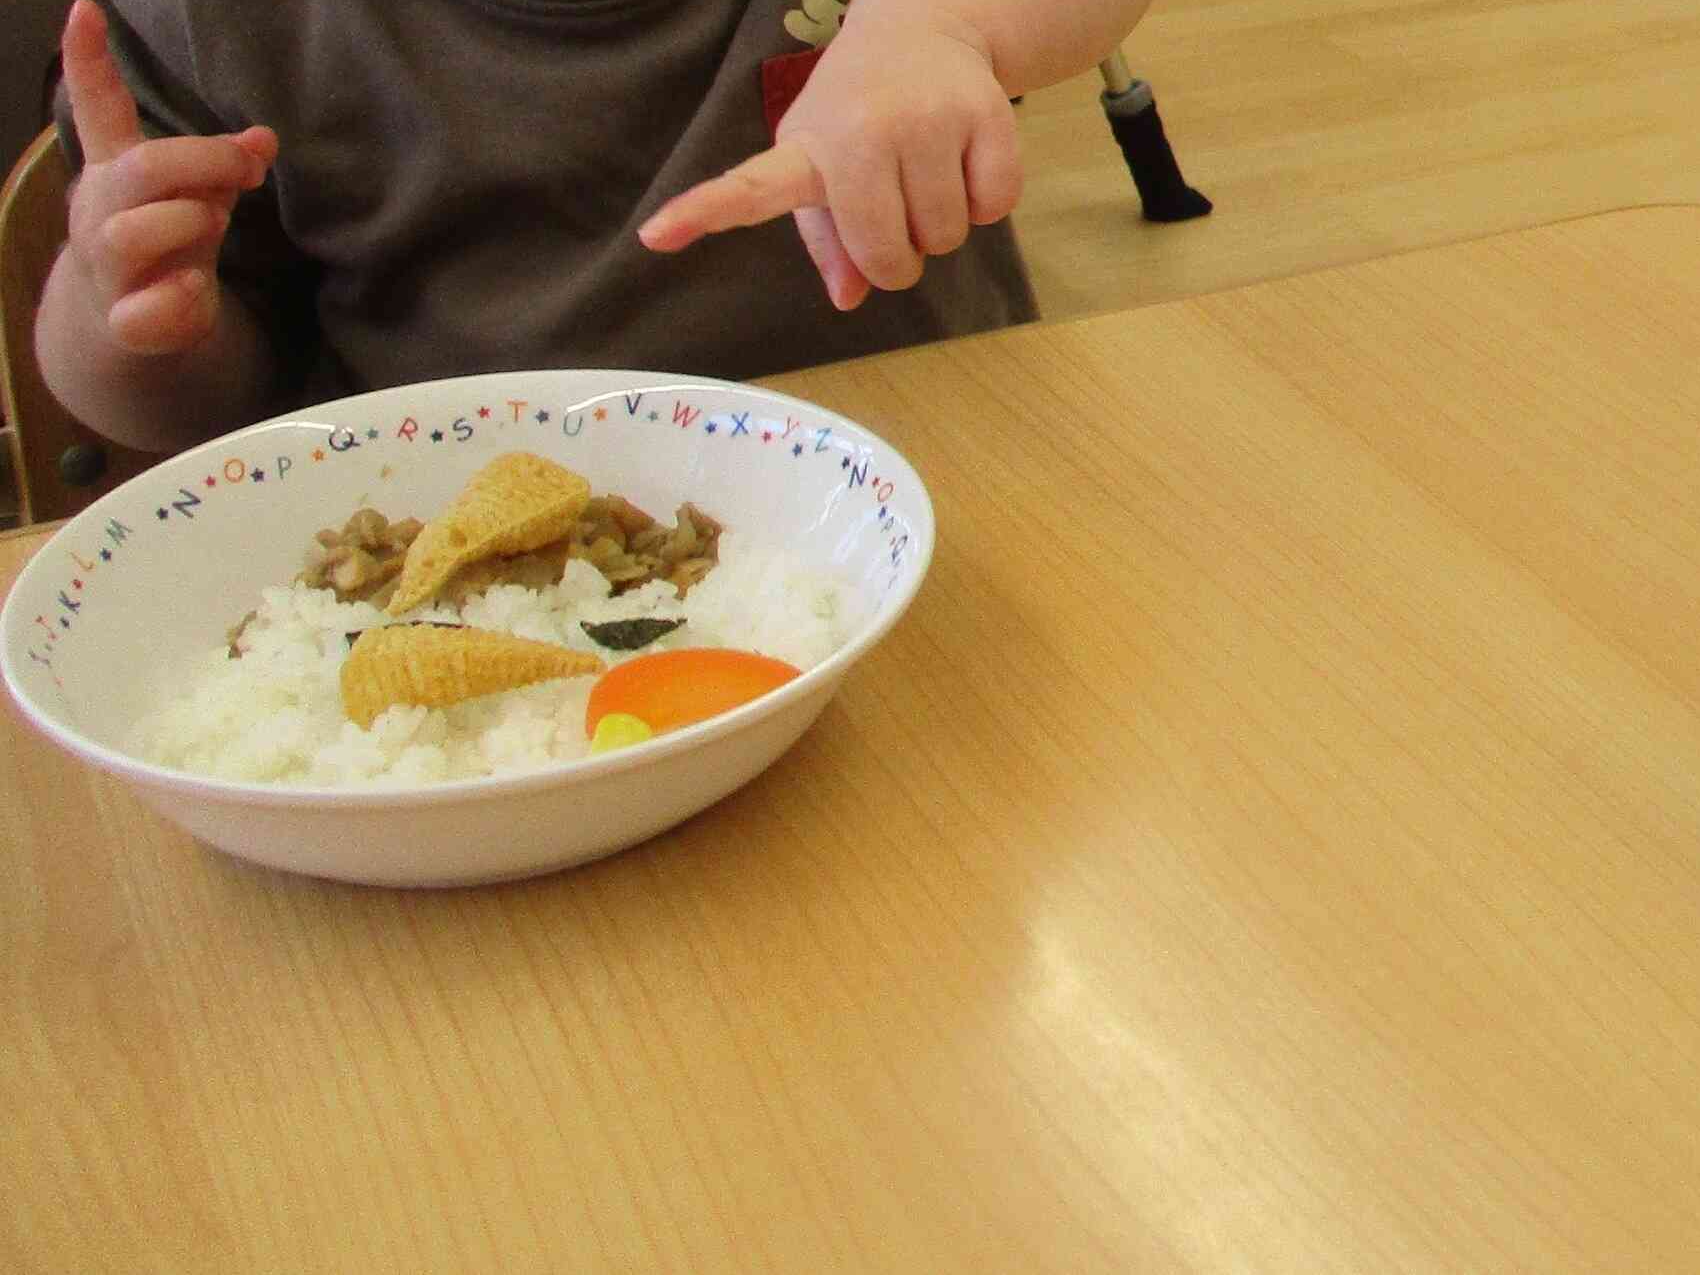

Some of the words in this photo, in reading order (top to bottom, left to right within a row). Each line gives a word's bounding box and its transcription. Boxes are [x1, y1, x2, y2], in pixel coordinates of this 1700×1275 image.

[171, 488, 201, 518] N
[224, 457, 246, 483] O
[277, 455, 293, 479] P
[329, 425, 361, 452] Q
[398, 416, 419, 442] R
[452, 417, 475, 442] S
[506, 399, 529, 422] T
[562, 415, 583, 437] U
[624, 392, 643, 417] V
[671, 400, 703, 429] W
[729, 412, 751, 438] X
[780, 415, 801, 439] Y
[815, 427, 832, 453] Z
[849, 462, 869, 489] N
[877, 482, 894, 502] O
